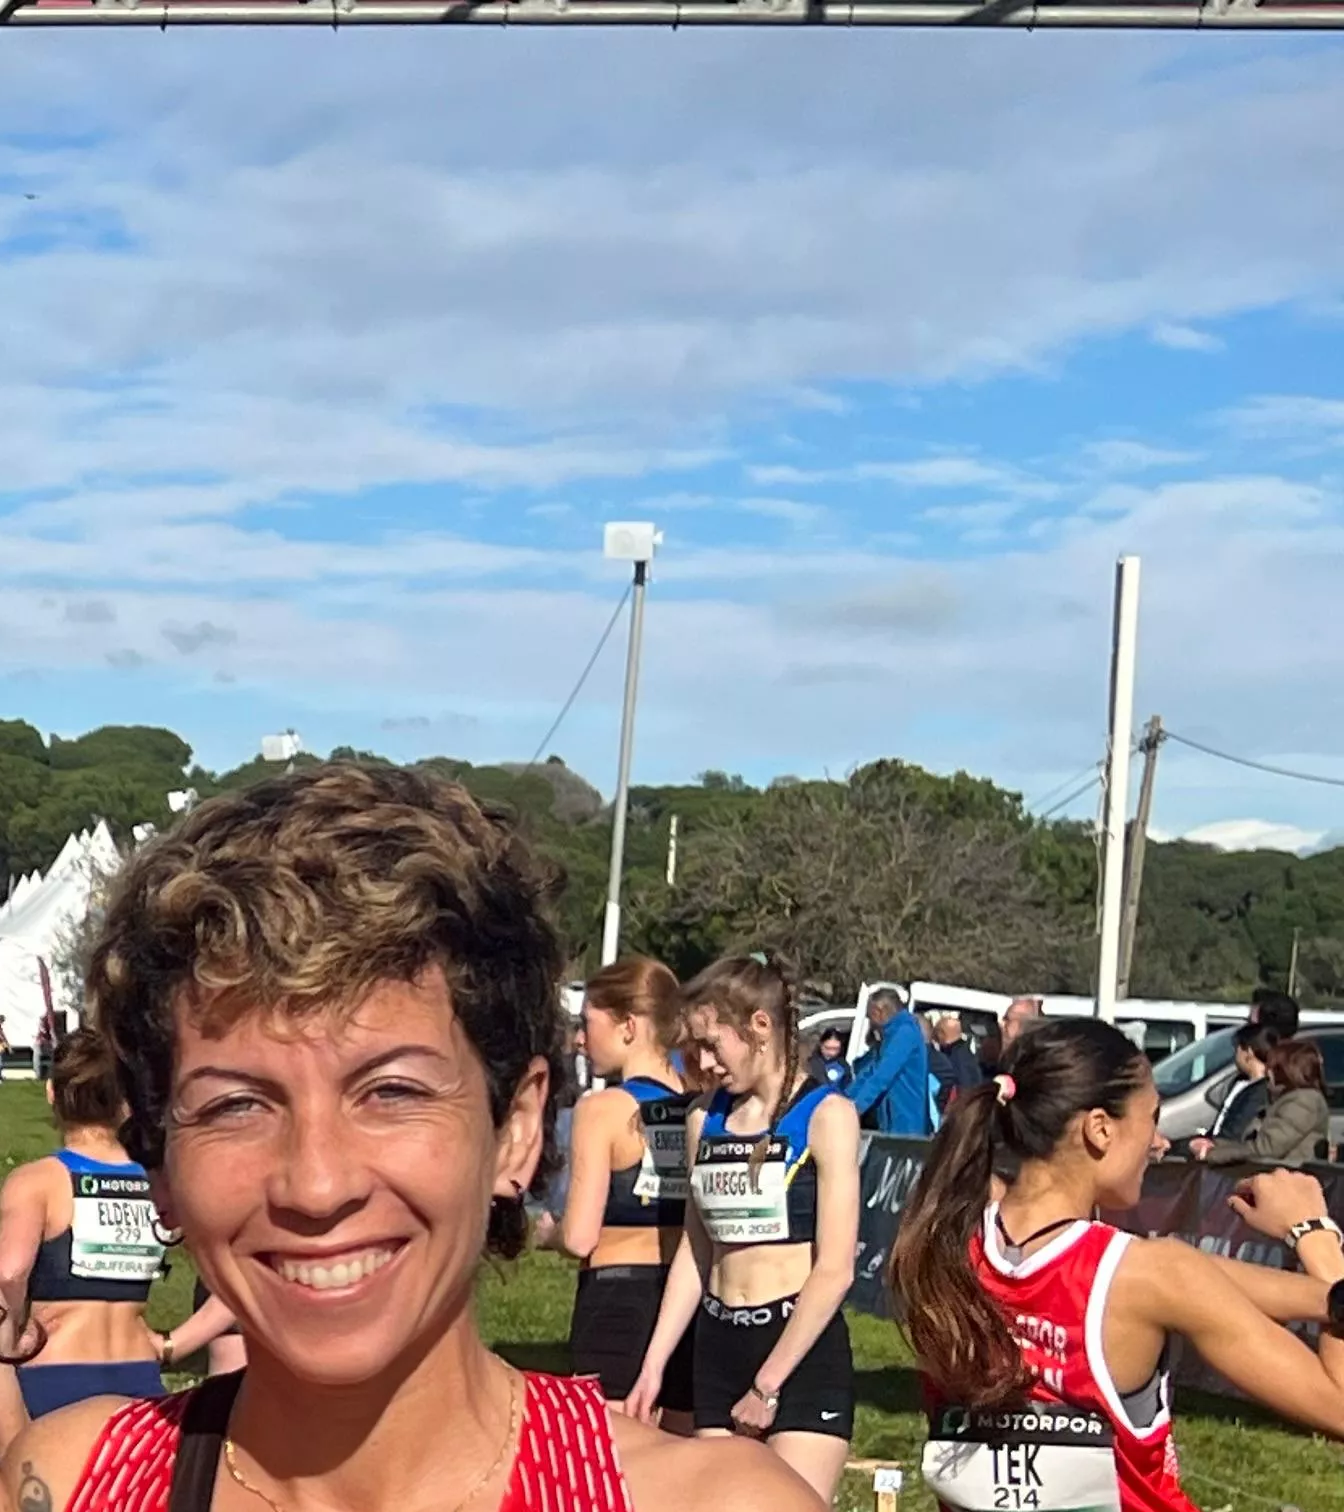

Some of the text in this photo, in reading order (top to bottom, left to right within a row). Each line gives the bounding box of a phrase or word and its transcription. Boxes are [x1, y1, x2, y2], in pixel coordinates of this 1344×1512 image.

[115, 1228, 141, 1243] 279
[977, 1413, 1102, 1435] MOTORPOR
[986, 1443, 1043, 1487] TEK
[994, 1488, 1041, 1510] 214
